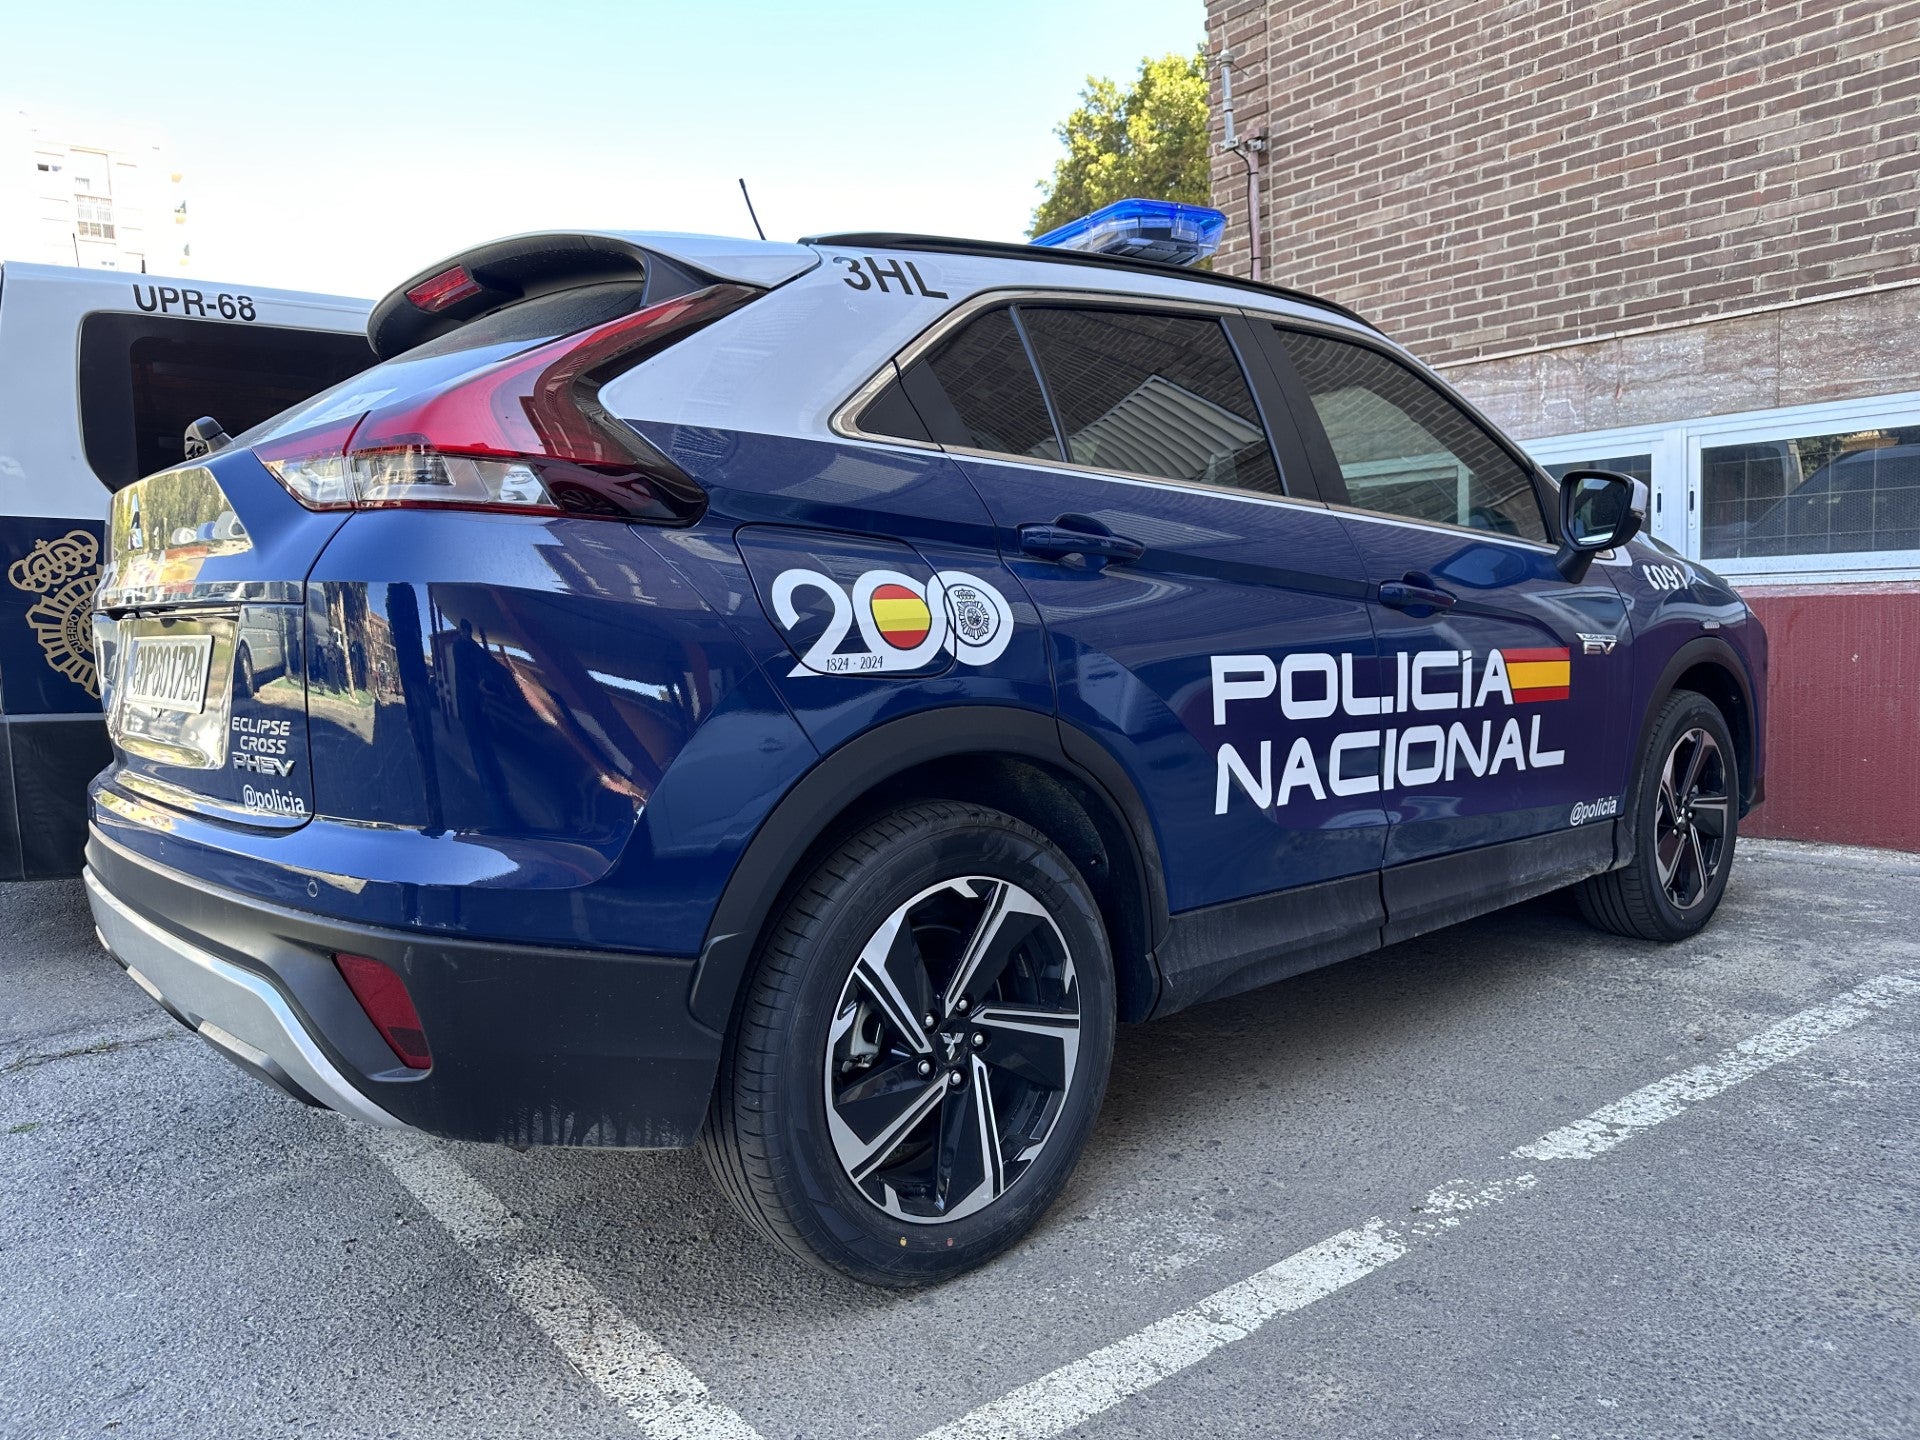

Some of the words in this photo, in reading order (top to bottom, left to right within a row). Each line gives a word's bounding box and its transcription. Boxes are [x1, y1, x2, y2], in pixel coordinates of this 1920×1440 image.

[832, 256, 949, 300] 3HL
[132, 284, 257, 322] UPR-68
[1650, 564, 1689, 590] 091
[66, 613, 86, 654] CUERPO
[771, 568, 1015, 678] 200
[826, 657, 849, 671] 1824
[860, 655, 883, 670] 2024
[1583, 641, 1616, 655] EV
[231, 716, 291, 737] ECLIPSE
[239, 735, 287, 755] CROSS
[231, 751, 296, 778] PHEV
[1214, 714, 1565, 816] NACIONAL
[243, 784, 306, 814] @policia
[1569, 796, 1618, 827] @policia
